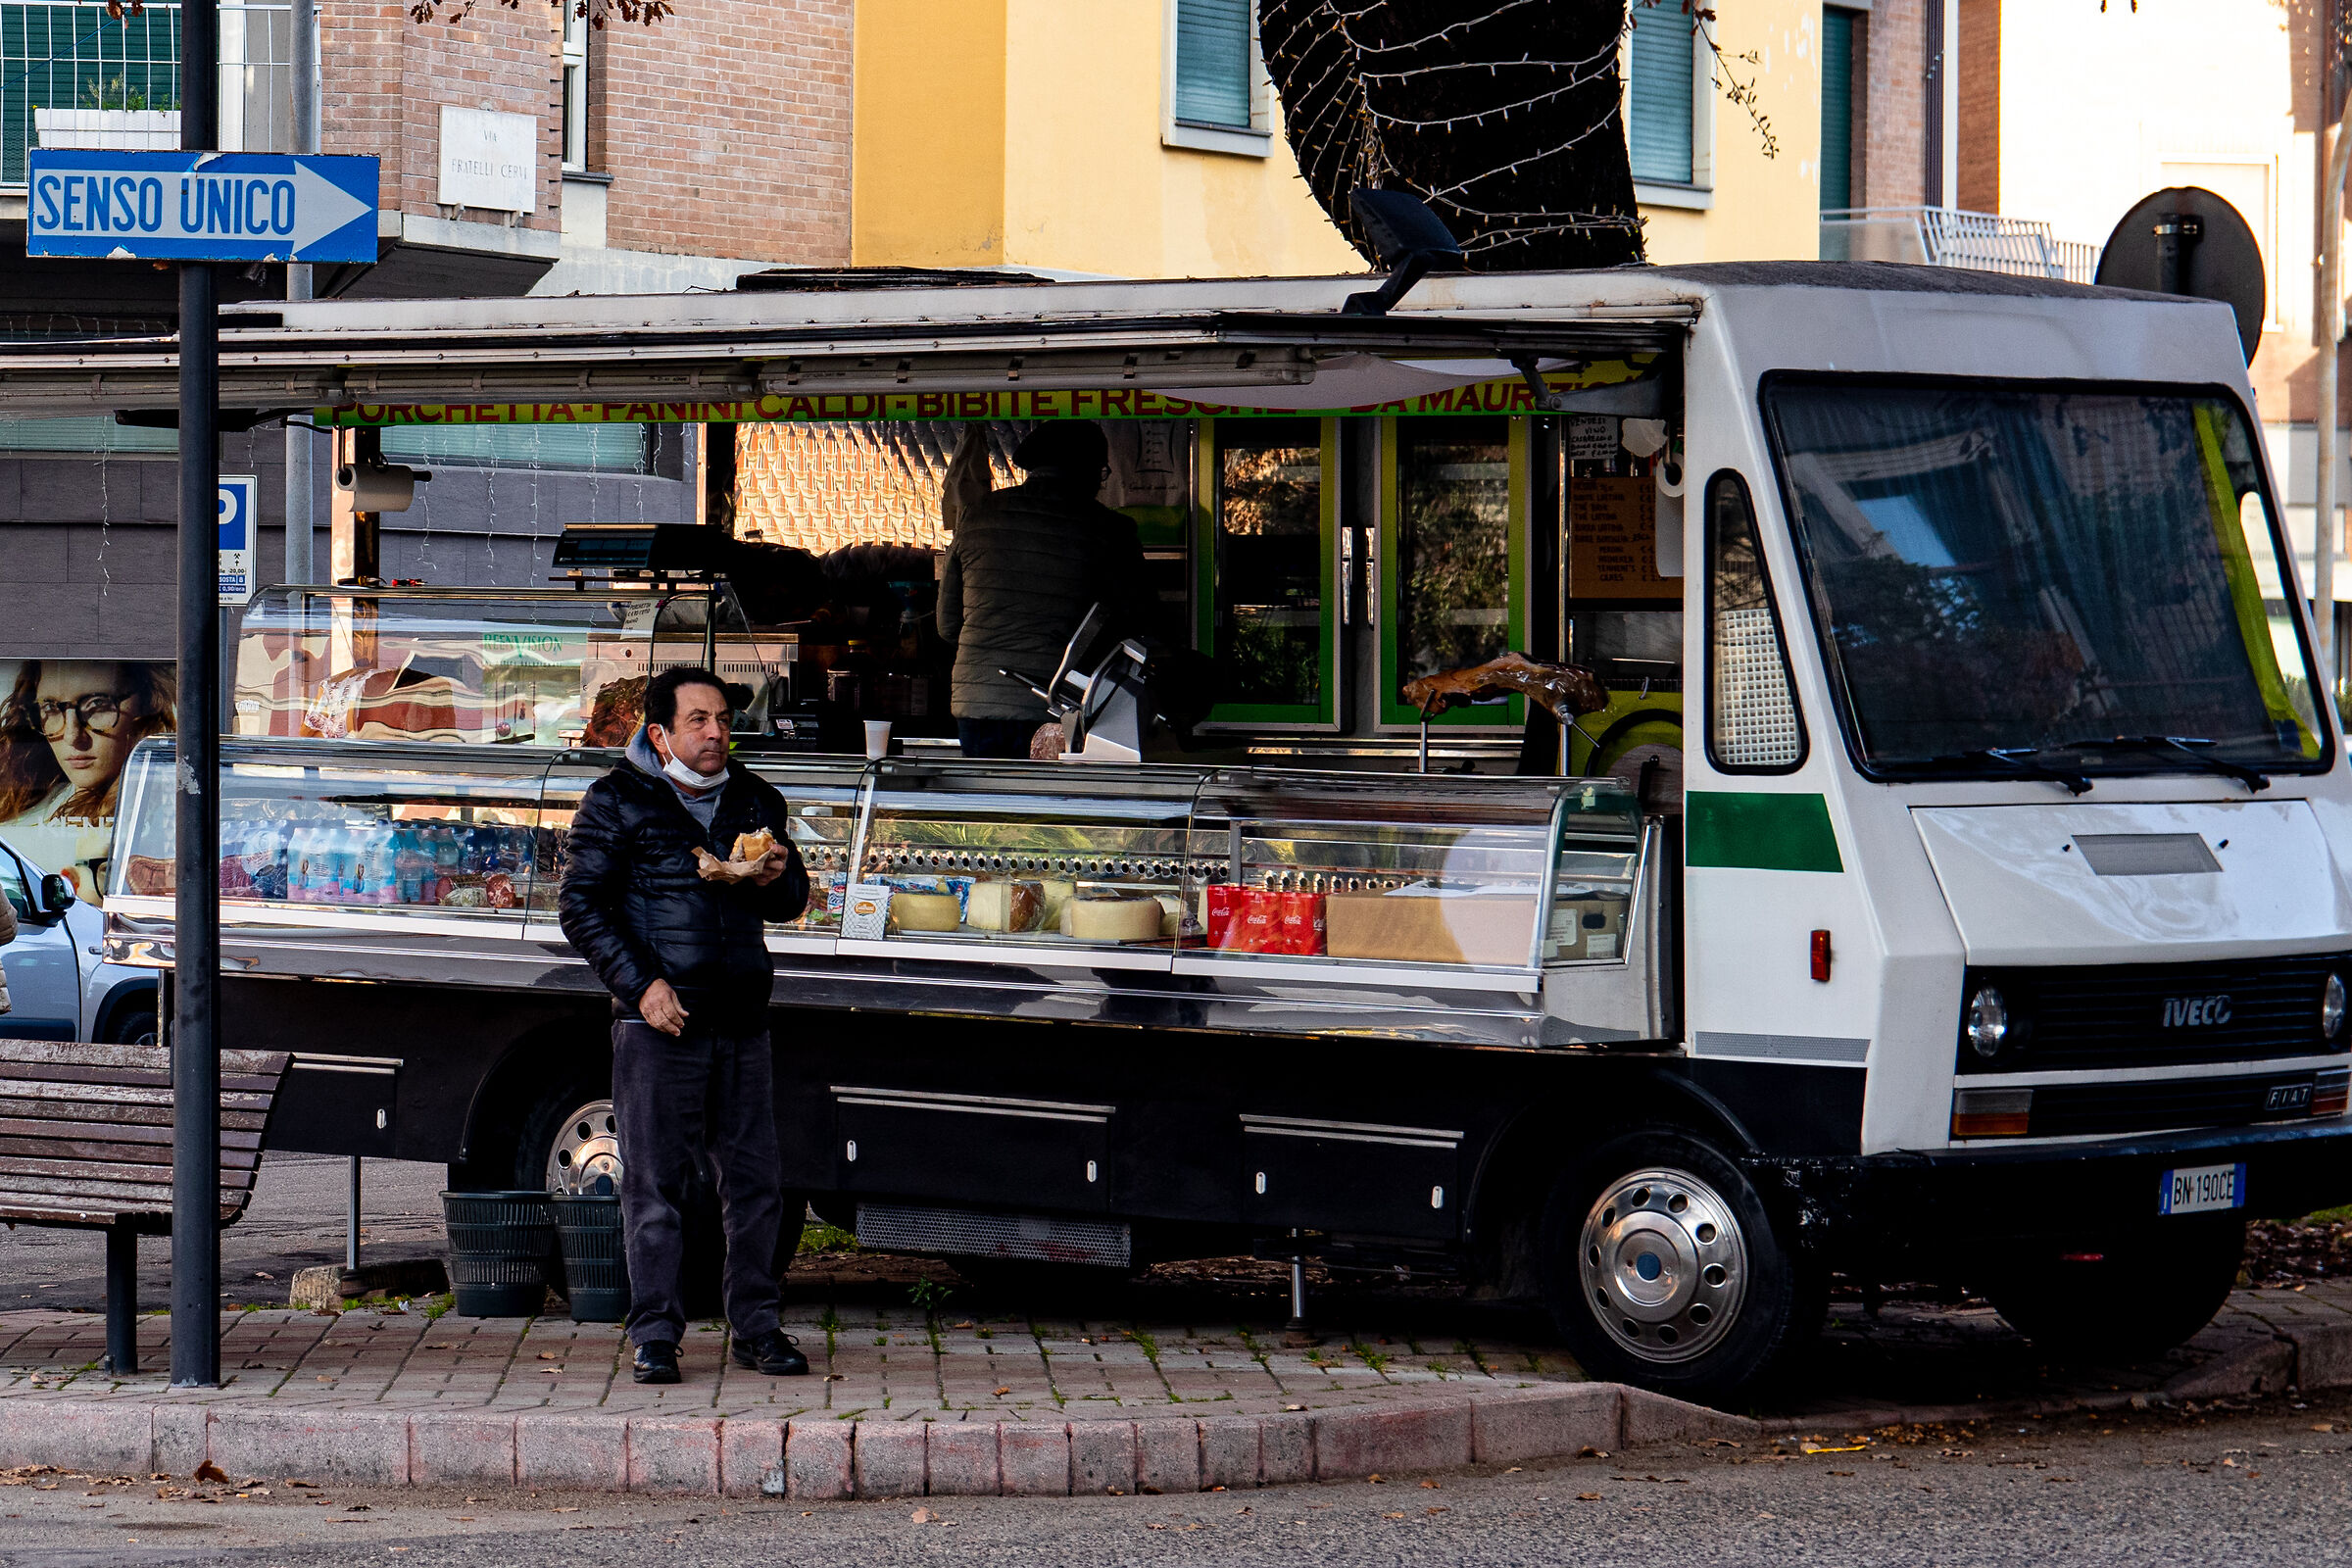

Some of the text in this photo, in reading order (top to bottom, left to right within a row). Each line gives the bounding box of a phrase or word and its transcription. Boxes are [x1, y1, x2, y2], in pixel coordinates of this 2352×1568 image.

[451, 158, 527, 180] FRATELLI CERVI
[36, 174, 296, 236] SENSO UNICO
[331, 403, 576, 422] PORCHETTA
[602, 402, 743, 420] PANINI
[755, 394, 887, 419] CALDI
[917, 392, 1058, 417] BIBITE
[2162, 995, 2232, 1027] IVECO
[2269, 1087, 2310, 1107] FIAT
